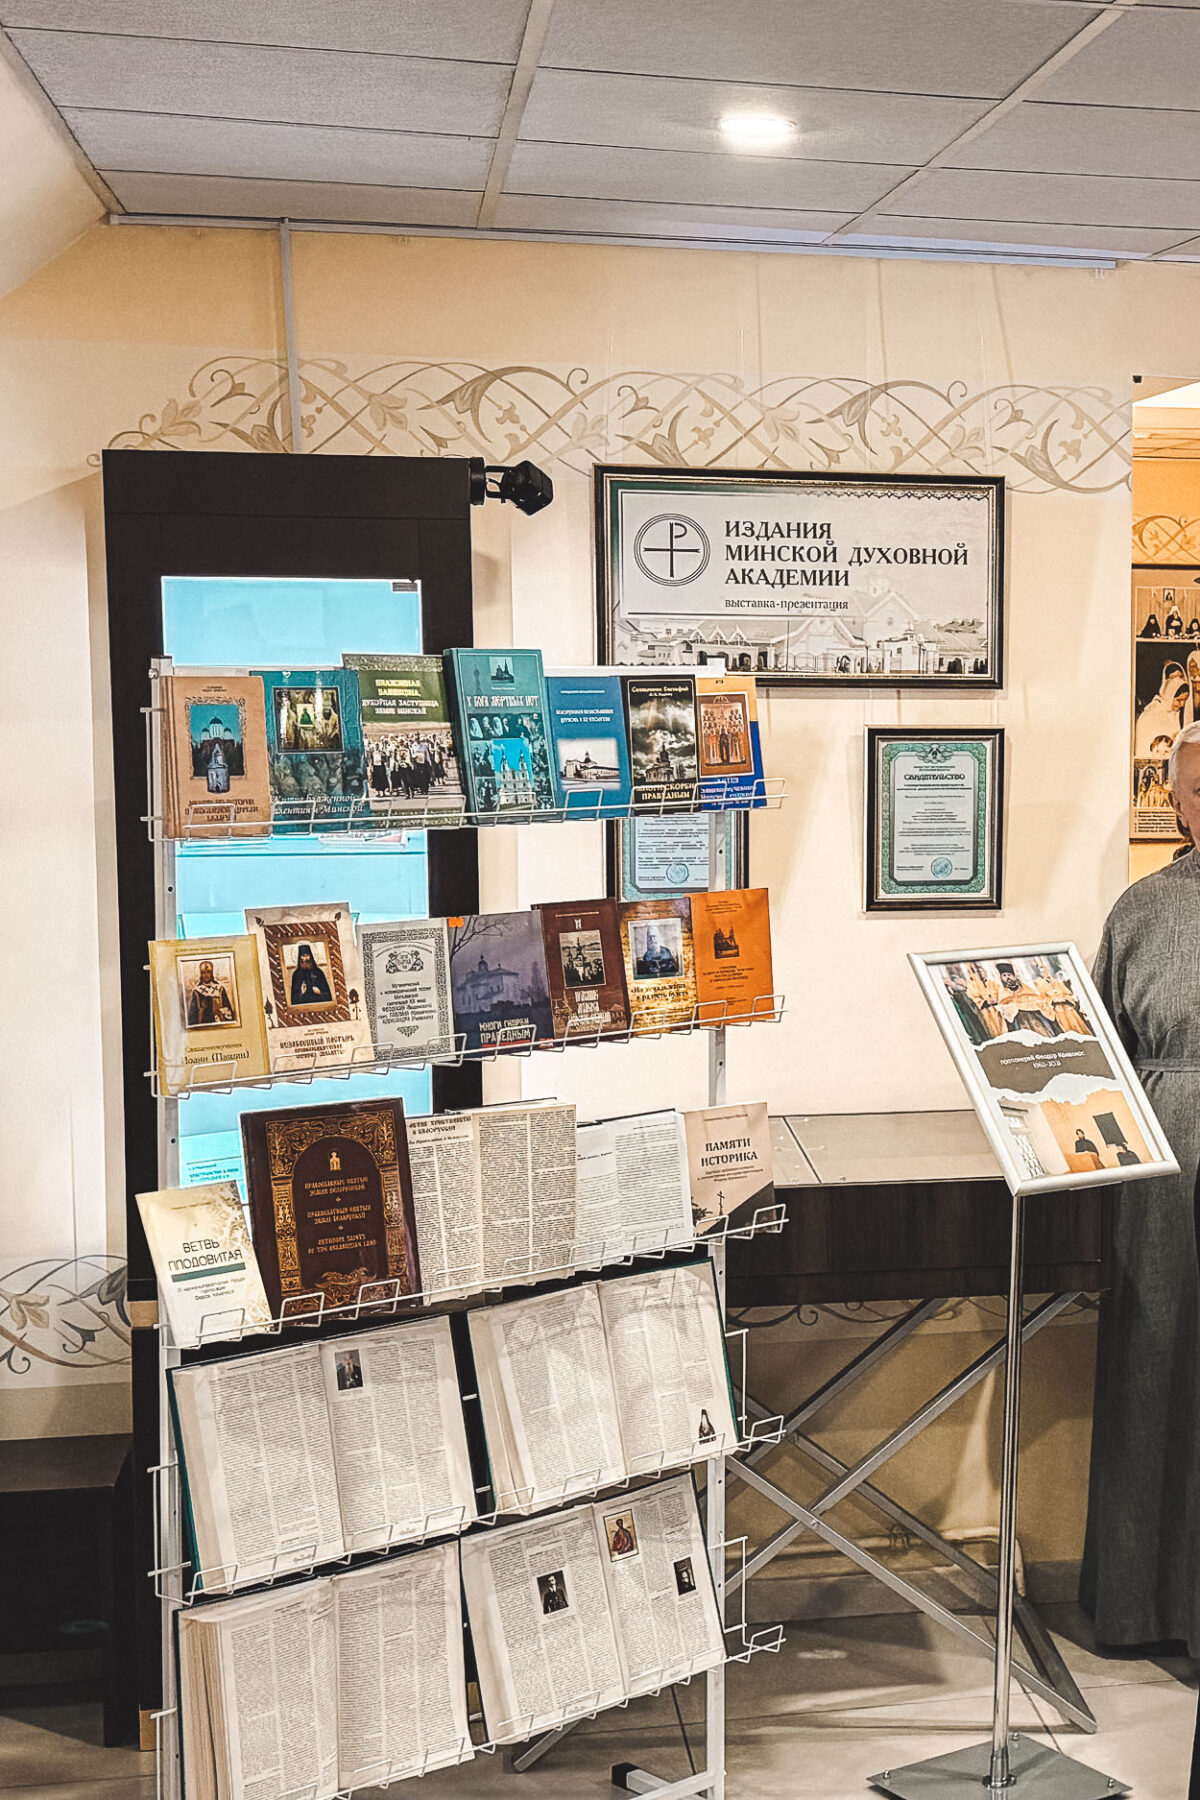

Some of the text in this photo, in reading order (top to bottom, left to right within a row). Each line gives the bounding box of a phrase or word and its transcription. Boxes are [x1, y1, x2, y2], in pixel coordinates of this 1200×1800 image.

[725, 520, 832, 540] ИЗДАНИЯ
[725, 539, 969, 566] МИНСКОЙ ДУХОВНОЙ
[725, 567, 850, 590] АКАДЕМИИ
[725, 598, 849, 612] выставка-презентация
[642, 791, 690, 800] ПРАВДНЫМ
[705, 1137, 751, 1152] ПАМЯТИ
[701, 1151, 758, 1167] ИСТОРИКА
[182, 1238, 221, 1254] ВЕТВЬ
[167, 1249, 243, 1272] ПЛОДОВИТАЯ
